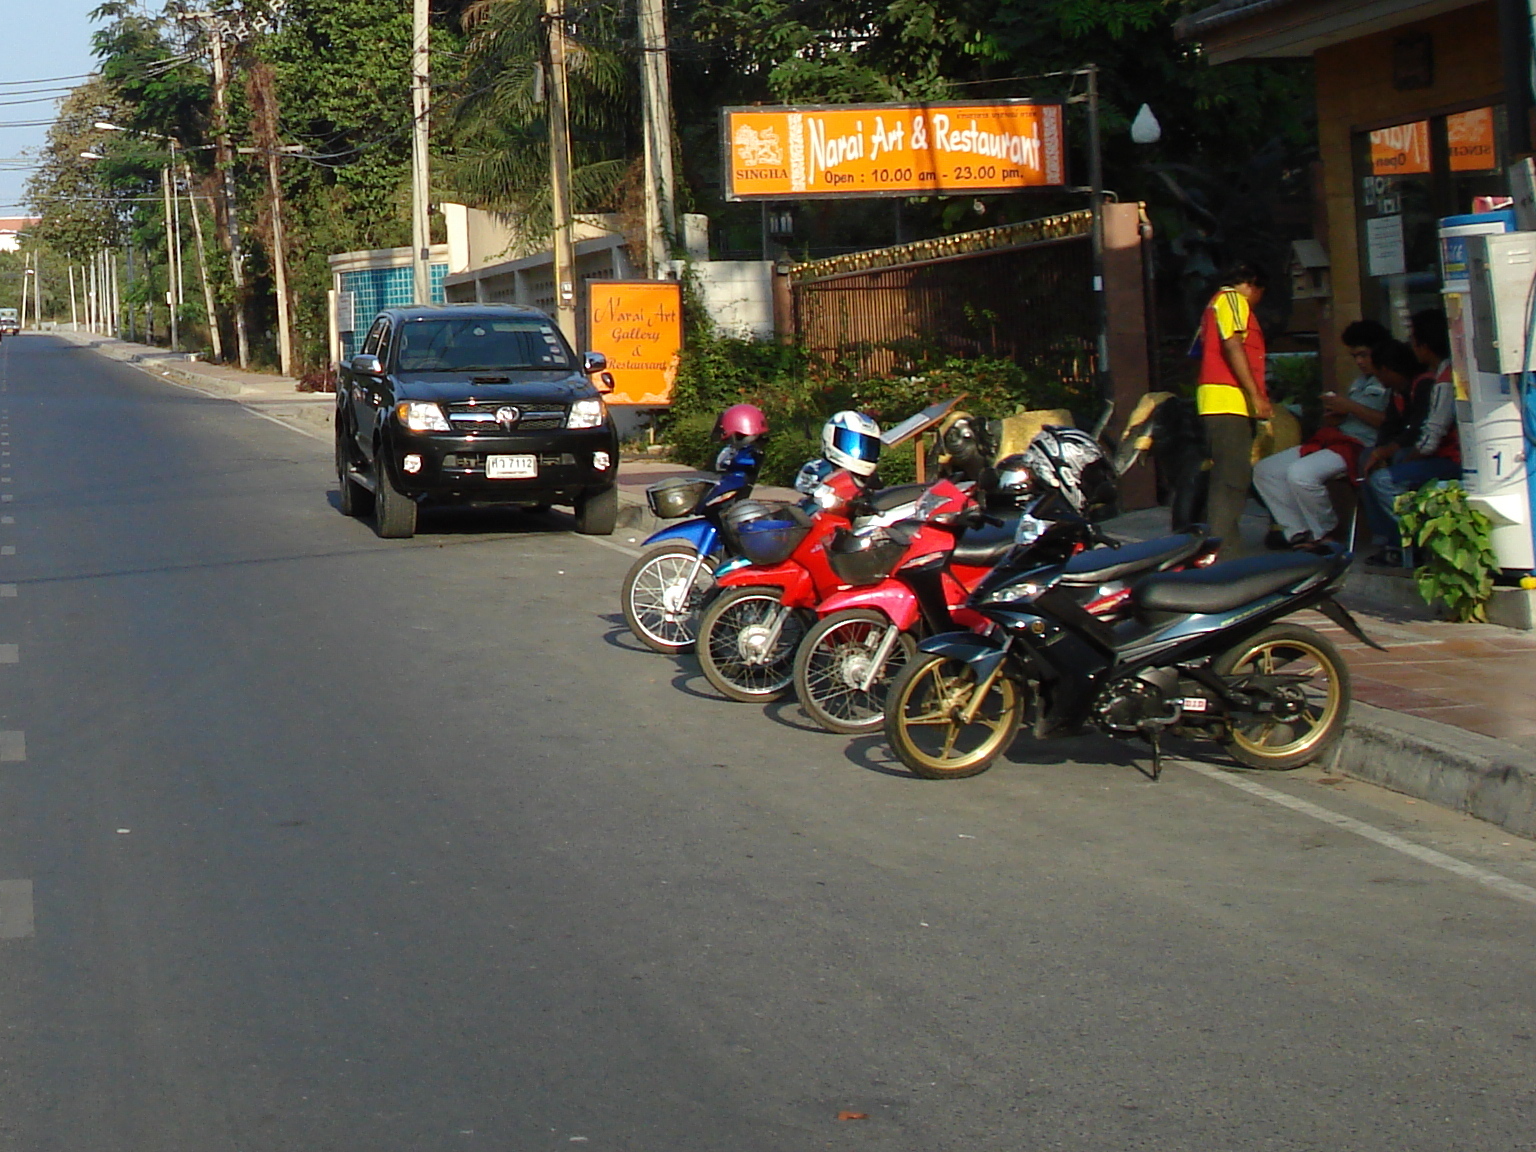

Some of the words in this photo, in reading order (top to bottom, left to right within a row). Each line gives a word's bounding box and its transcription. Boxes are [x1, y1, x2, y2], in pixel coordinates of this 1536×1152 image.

[807, 117, 864, 185] Narai
[870, 115, 905, 161] Art
[911, 115, 929, 150] &
[932, 113, 1041, 171] Restaurant
[736, 168, 789, 180] SINGHA
[824, 170, 855, 186] Open
[871, 168, 912, 182] 10.00
[918, 171, 937, 181] am
[953, 166, 996, 180] 23.00
[1002, 168, 1024, 182] pm.
[594, 297, 644, 323] Narai
[647, 303, 677, 327] Art
[611, 327, 660, 343] Gallery
[631, 344, 642, 357] &
[509, 458, 532, 468] 7112
